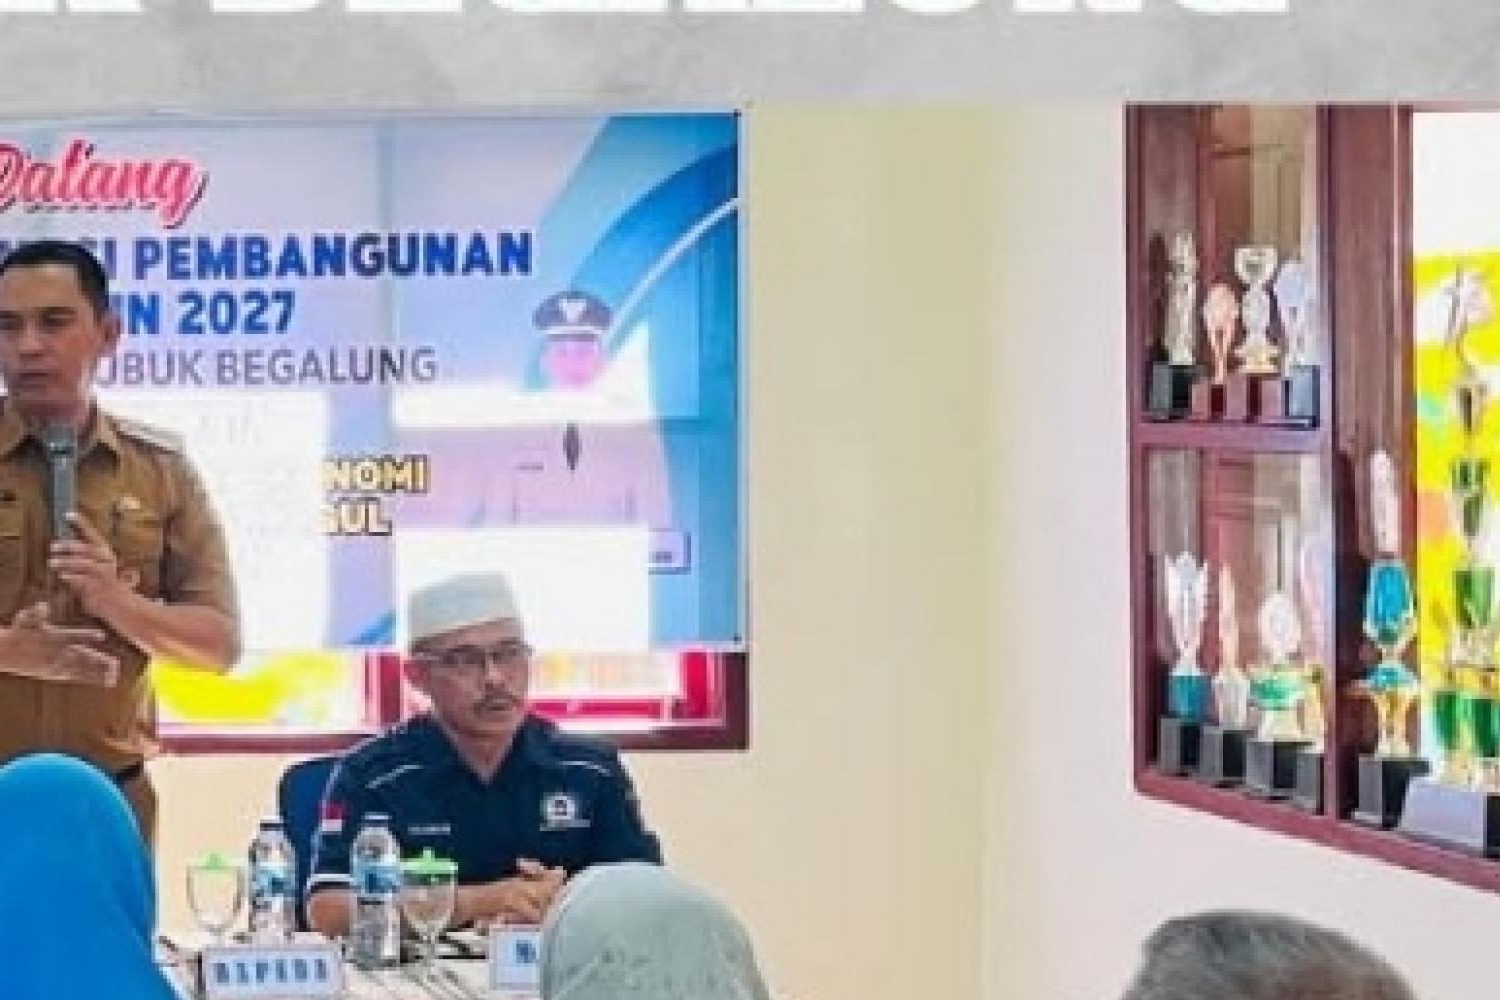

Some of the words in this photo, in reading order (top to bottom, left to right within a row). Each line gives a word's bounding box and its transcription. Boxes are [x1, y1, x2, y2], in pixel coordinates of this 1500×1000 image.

[134, 232, 532, 280] PEMBANGUNAN
[177, 290, 296, 335] 2027
[94, 350, 203, 387] UBUK
[216, 345, 438, 386] BEGALUNG
[323, 454, 429, 493] NOMI
